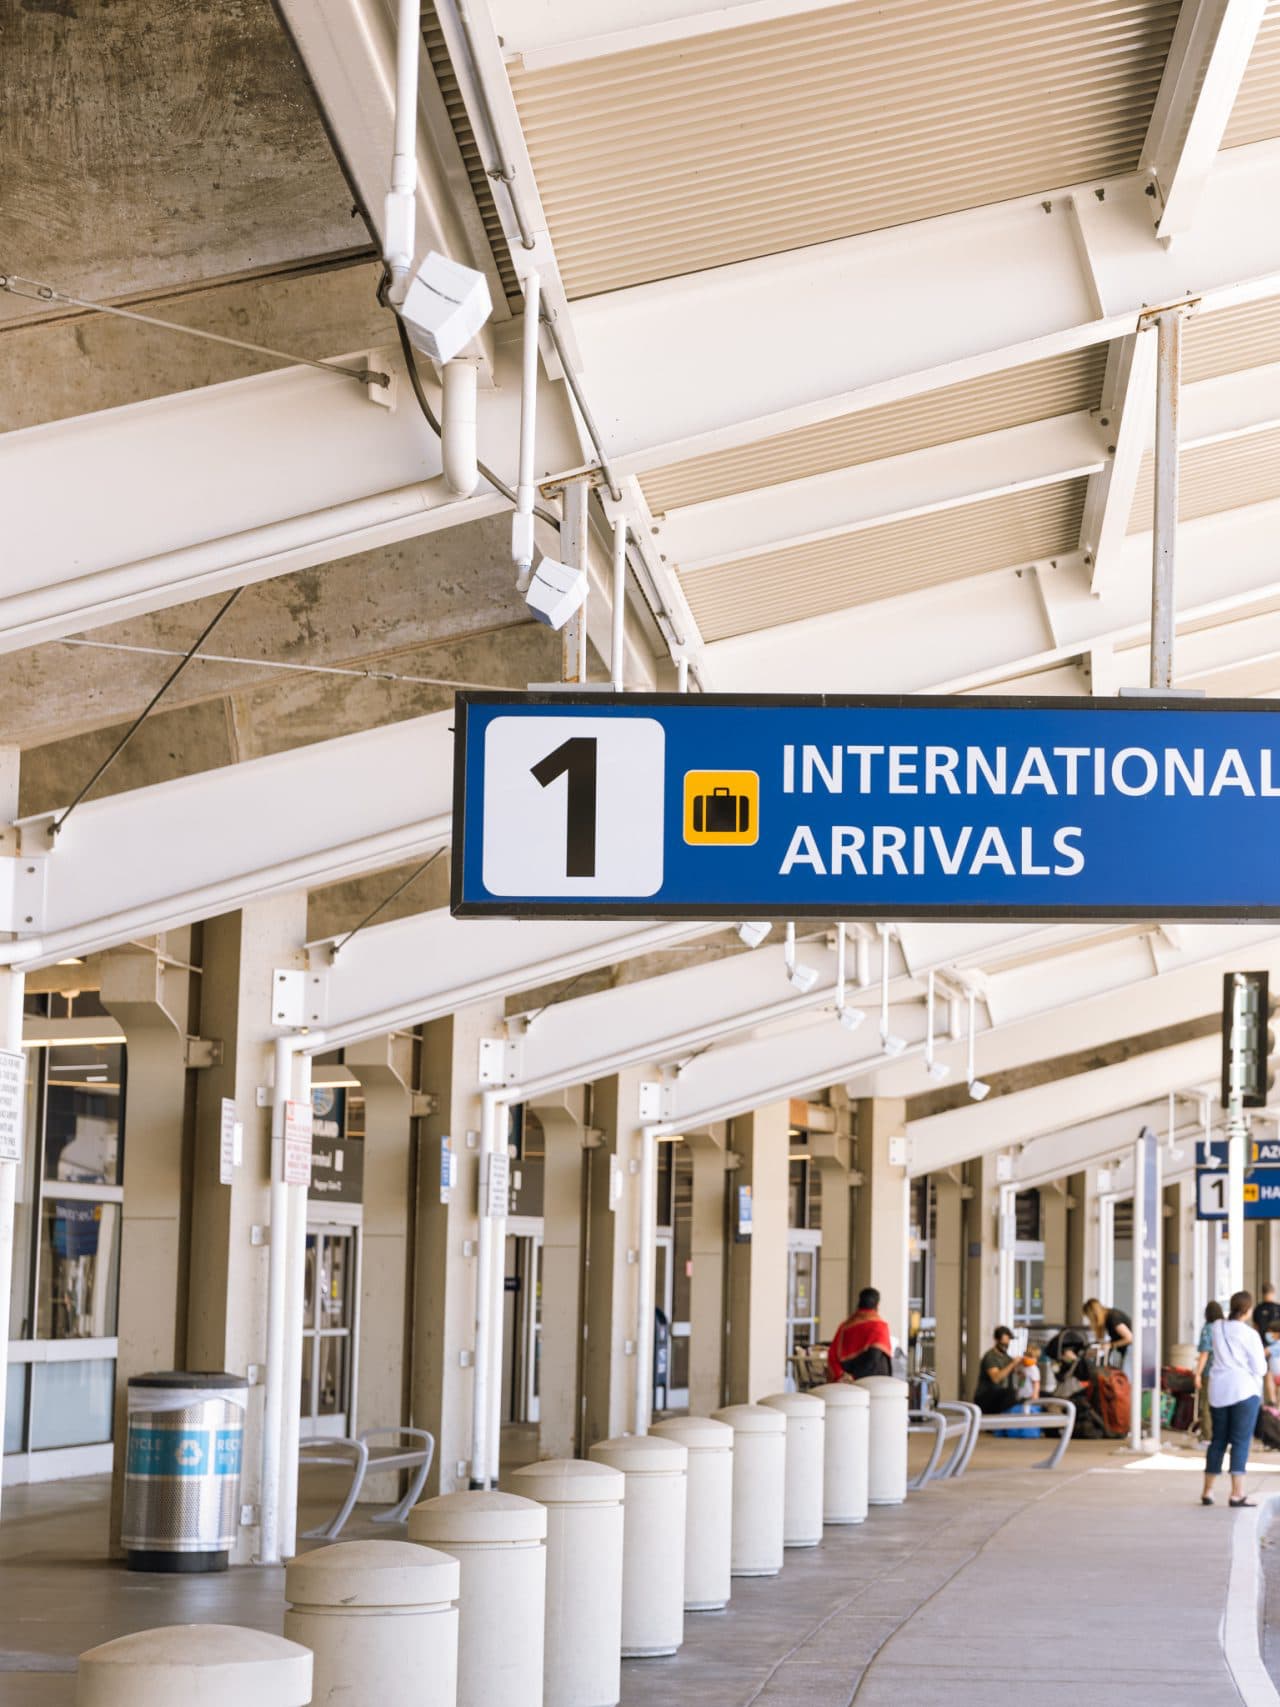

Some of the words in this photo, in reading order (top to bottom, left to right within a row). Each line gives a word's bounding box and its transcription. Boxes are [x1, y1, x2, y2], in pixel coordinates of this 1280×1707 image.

[529, 737, 598, 878] 1
[778, 825, 1085, 876] ARRIVALS
[1211, 1179, 1224, 1208] 1
